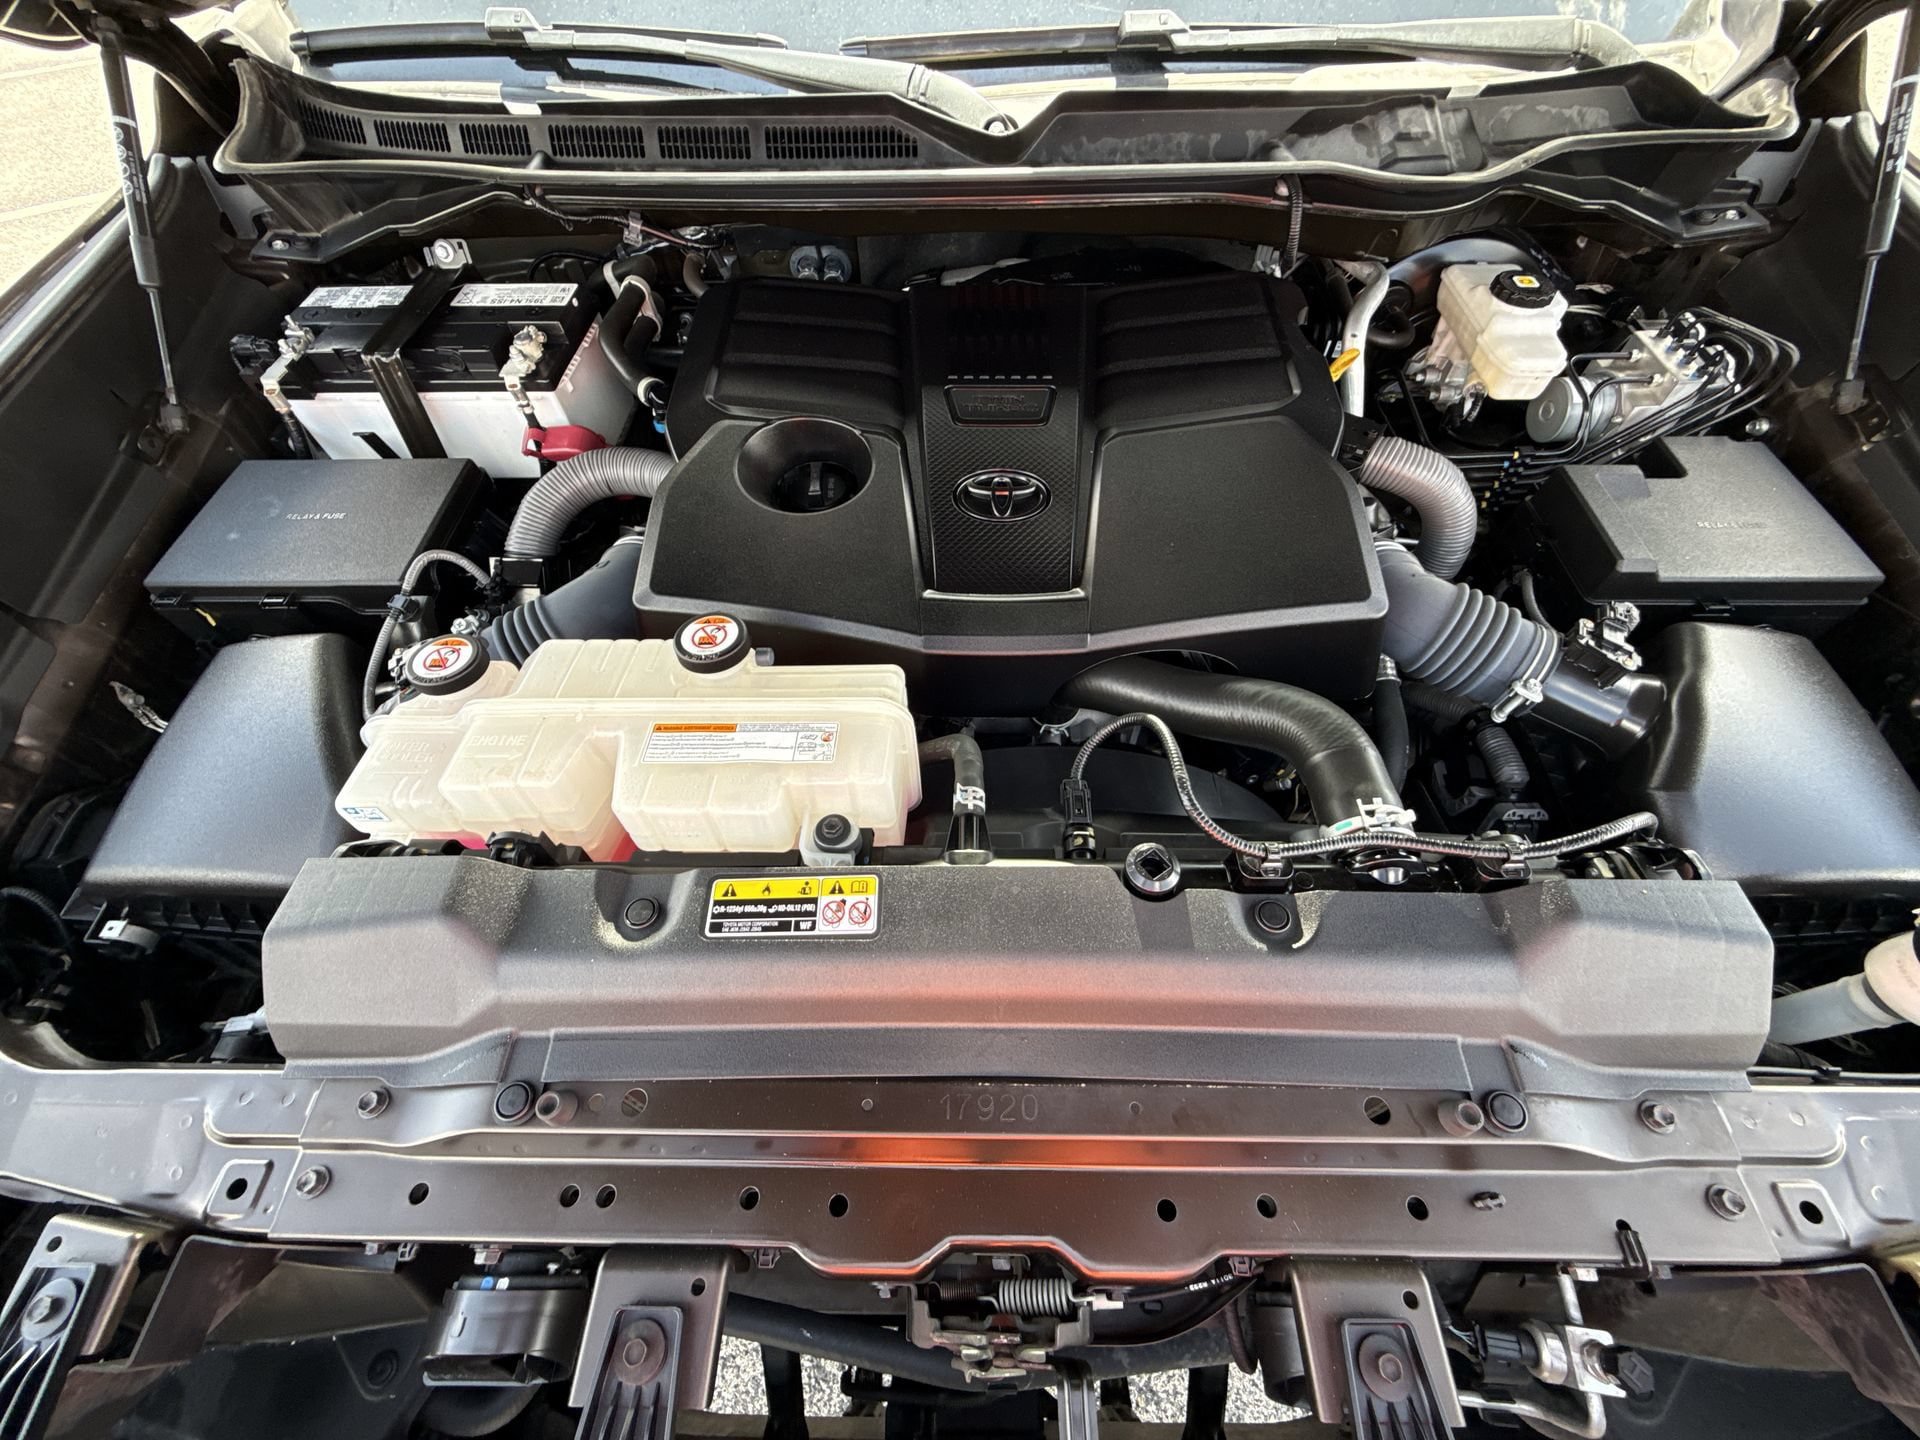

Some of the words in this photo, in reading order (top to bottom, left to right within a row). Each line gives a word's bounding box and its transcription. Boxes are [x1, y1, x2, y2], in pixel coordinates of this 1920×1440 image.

[321, 512, 347, 520] FUSE
[469, 734, 530, 747] ENGINE
[799, 921, 812, 930] WF
[940, 1093, 1039, 1121] 17920
